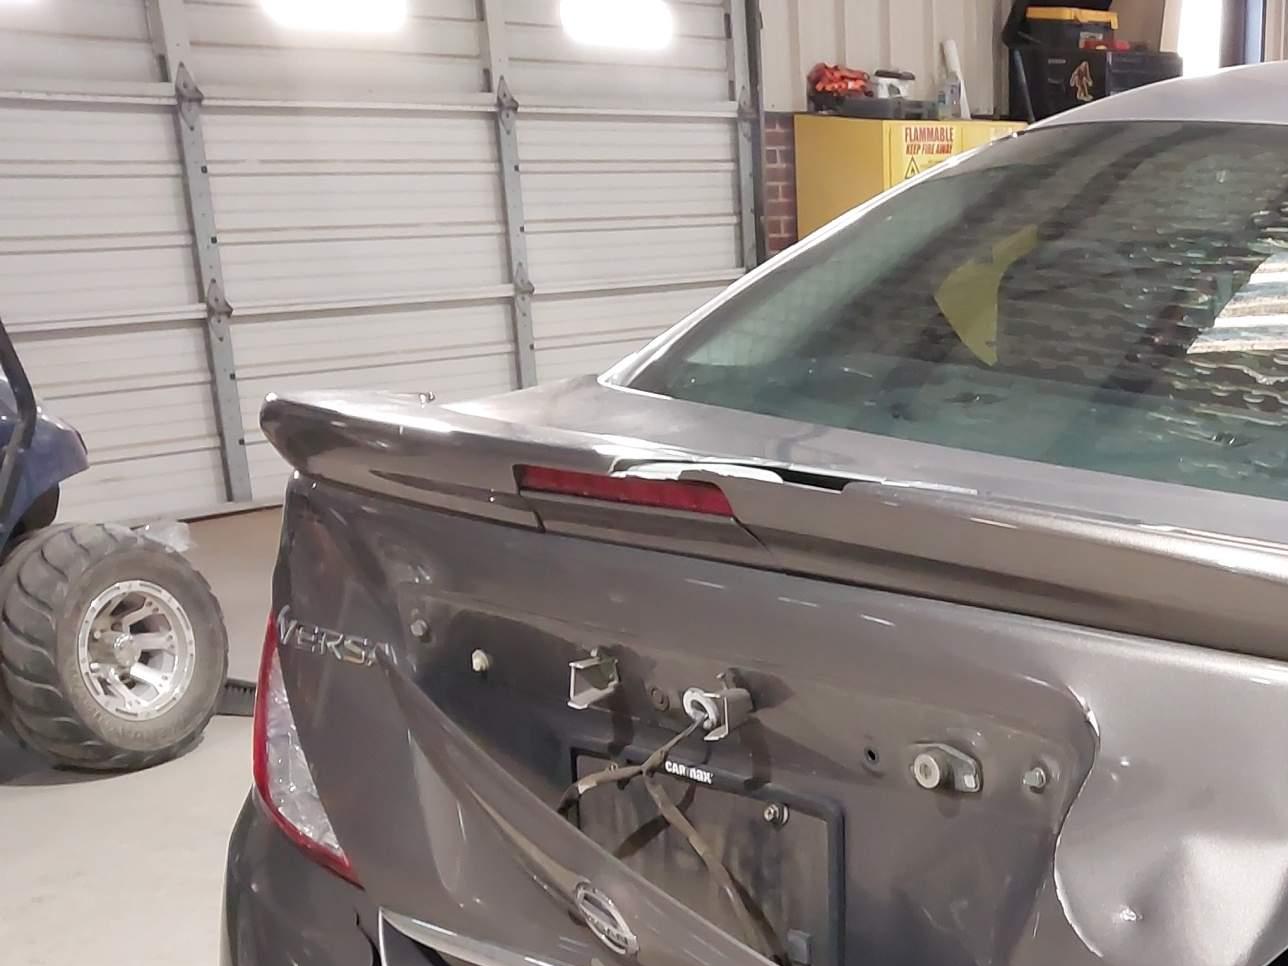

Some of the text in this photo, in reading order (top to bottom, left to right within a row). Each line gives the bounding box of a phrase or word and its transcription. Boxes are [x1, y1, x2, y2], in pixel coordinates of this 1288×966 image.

[905, 127, 954, 142] FLAMMABLE
[906, 143, 921, 155] KEEP
[936, 142, 953, 154] AWAY
